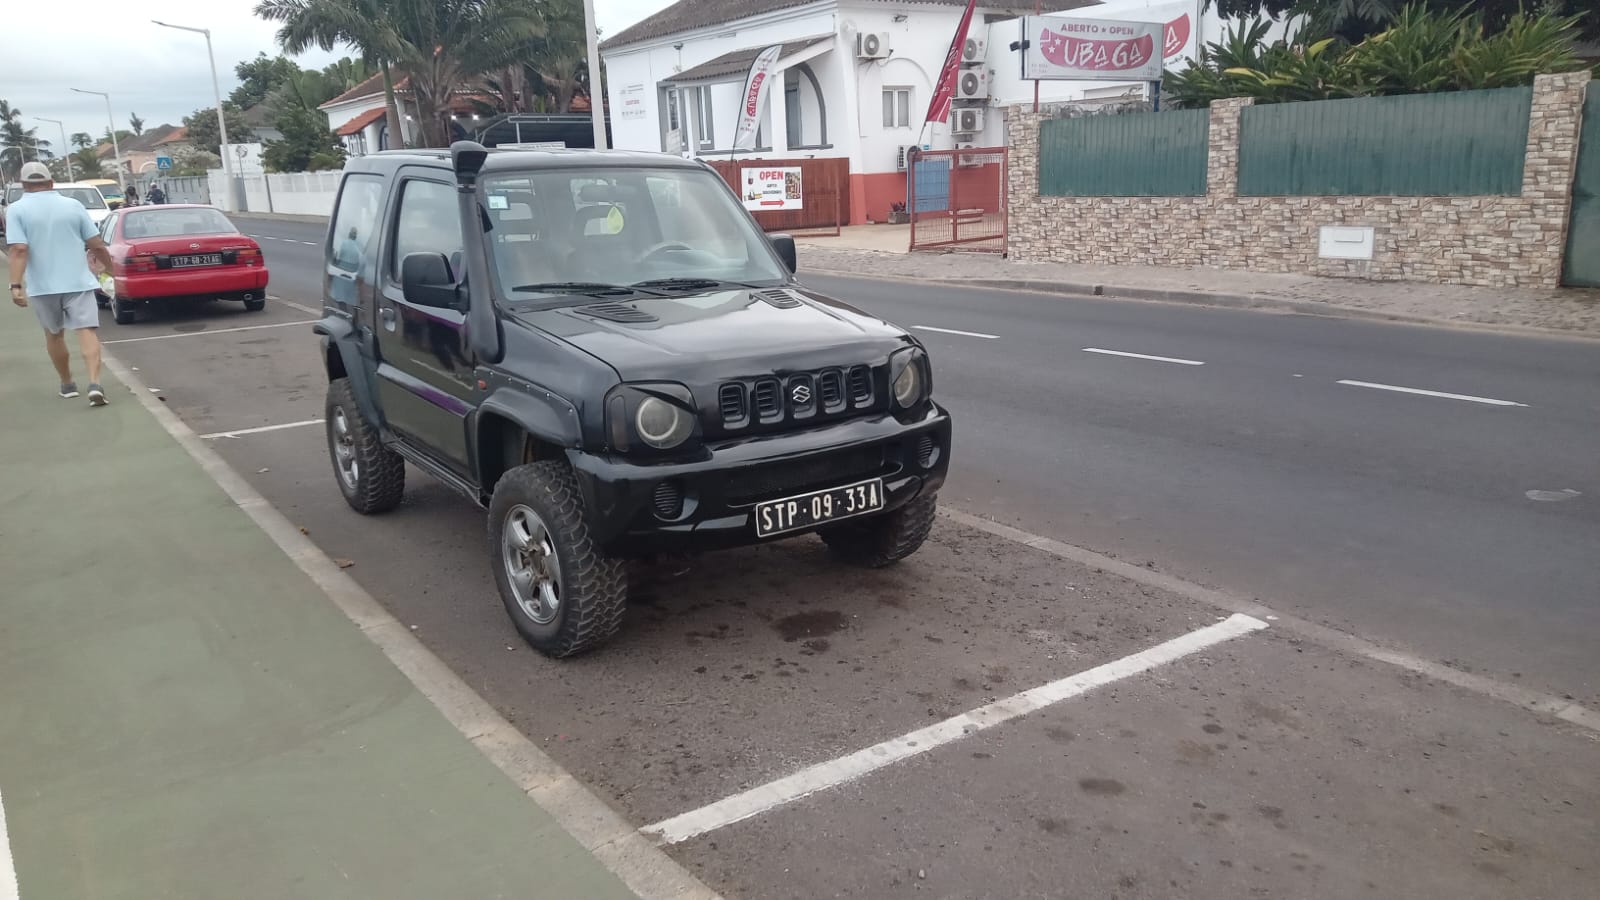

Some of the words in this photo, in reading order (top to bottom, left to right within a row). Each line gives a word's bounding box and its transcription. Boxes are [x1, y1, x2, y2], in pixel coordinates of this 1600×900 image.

[1061, 23, 1099, 33] ABERTO
[1109, 25, 1134, 35] OPEN
[1064, 38, 1143, 69] UBAGA
[759, 170, 784, 181] OPEN
